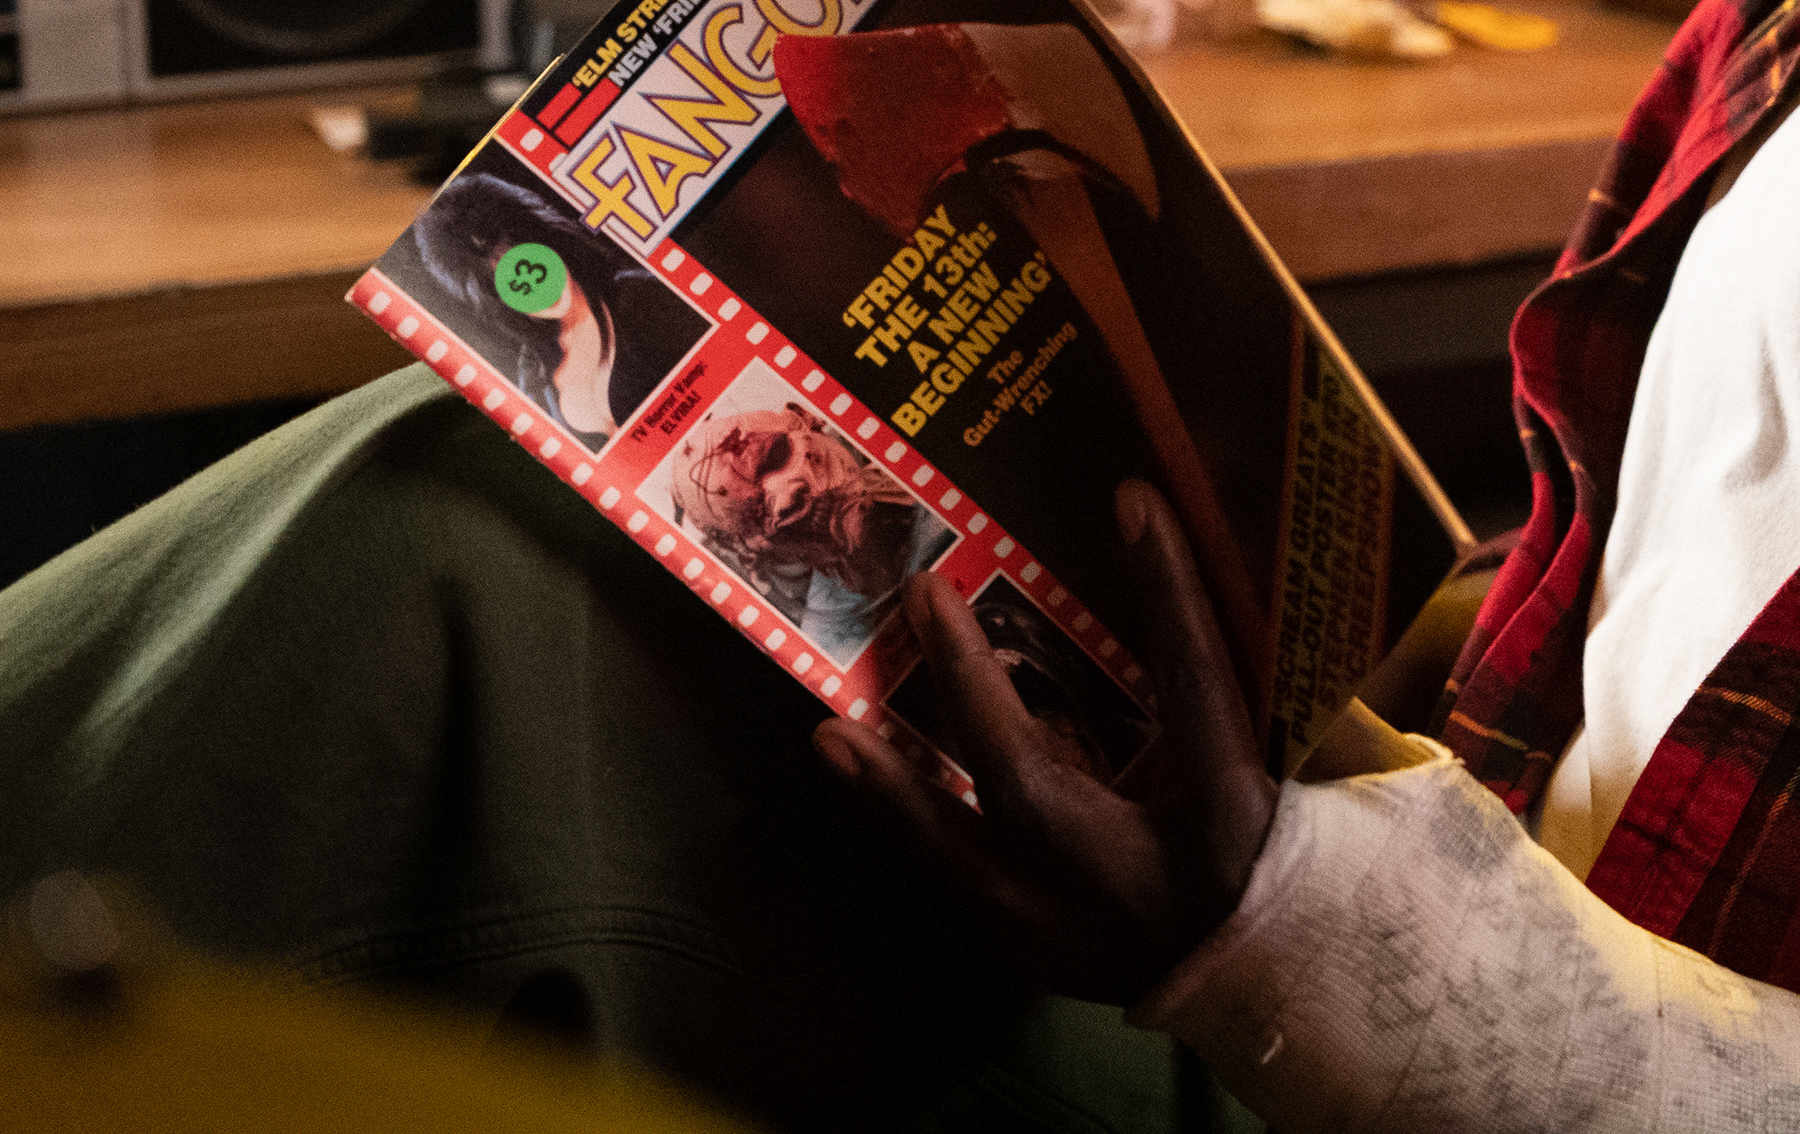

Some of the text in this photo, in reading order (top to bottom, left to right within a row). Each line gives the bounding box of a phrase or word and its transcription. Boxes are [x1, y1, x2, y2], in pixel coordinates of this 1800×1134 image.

[573, 39, 622, 86] 'ELM
[608, 34, 656, 86] NEW
[506, 259, 546, 295] $3
[843, 207, 954, 328] 'FRIDAY
[856, 224, 995, 366] THE 13th:
[892, 250, 1053, 436] BEGINNING'
[908, 263, 998, 372] A NEW
[963, 324, 1075, 446] Gut-Wrenching
[987, 351, 1022, 383] The
[1020, 381, 1051, 415] FX!
[631, 425, 648, 441] TV
[643, 392, 677, 428] Horror
[1313, 440, 1339, 575] POSTER
